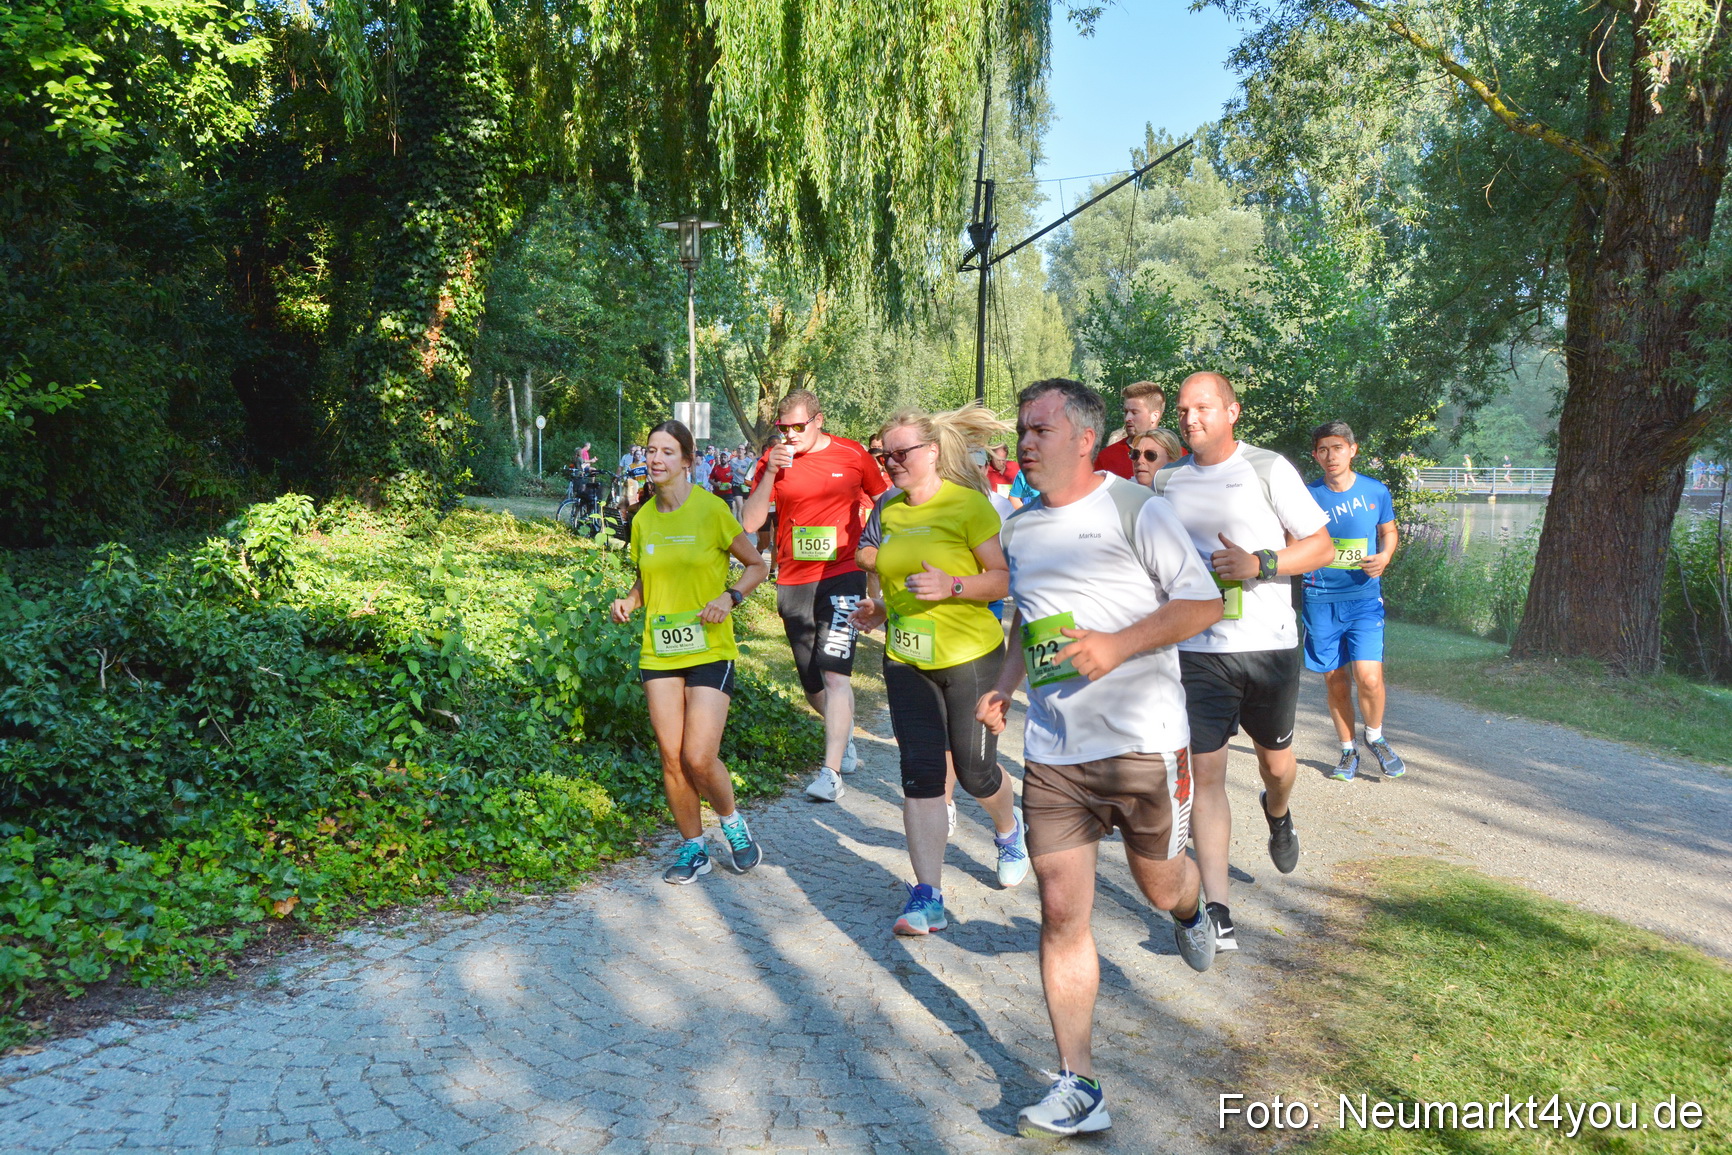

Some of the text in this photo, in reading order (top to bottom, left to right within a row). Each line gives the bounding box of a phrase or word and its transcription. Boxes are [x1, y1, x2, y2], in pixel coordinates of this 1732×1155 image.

[1078, 532, 1102, 540] Markus
[797, 538, 831, 551] 1505
[1337, 549, 1362, 561] 738
[661, 627, 694, 645] 903
[895, 628, 919, 650] 951
